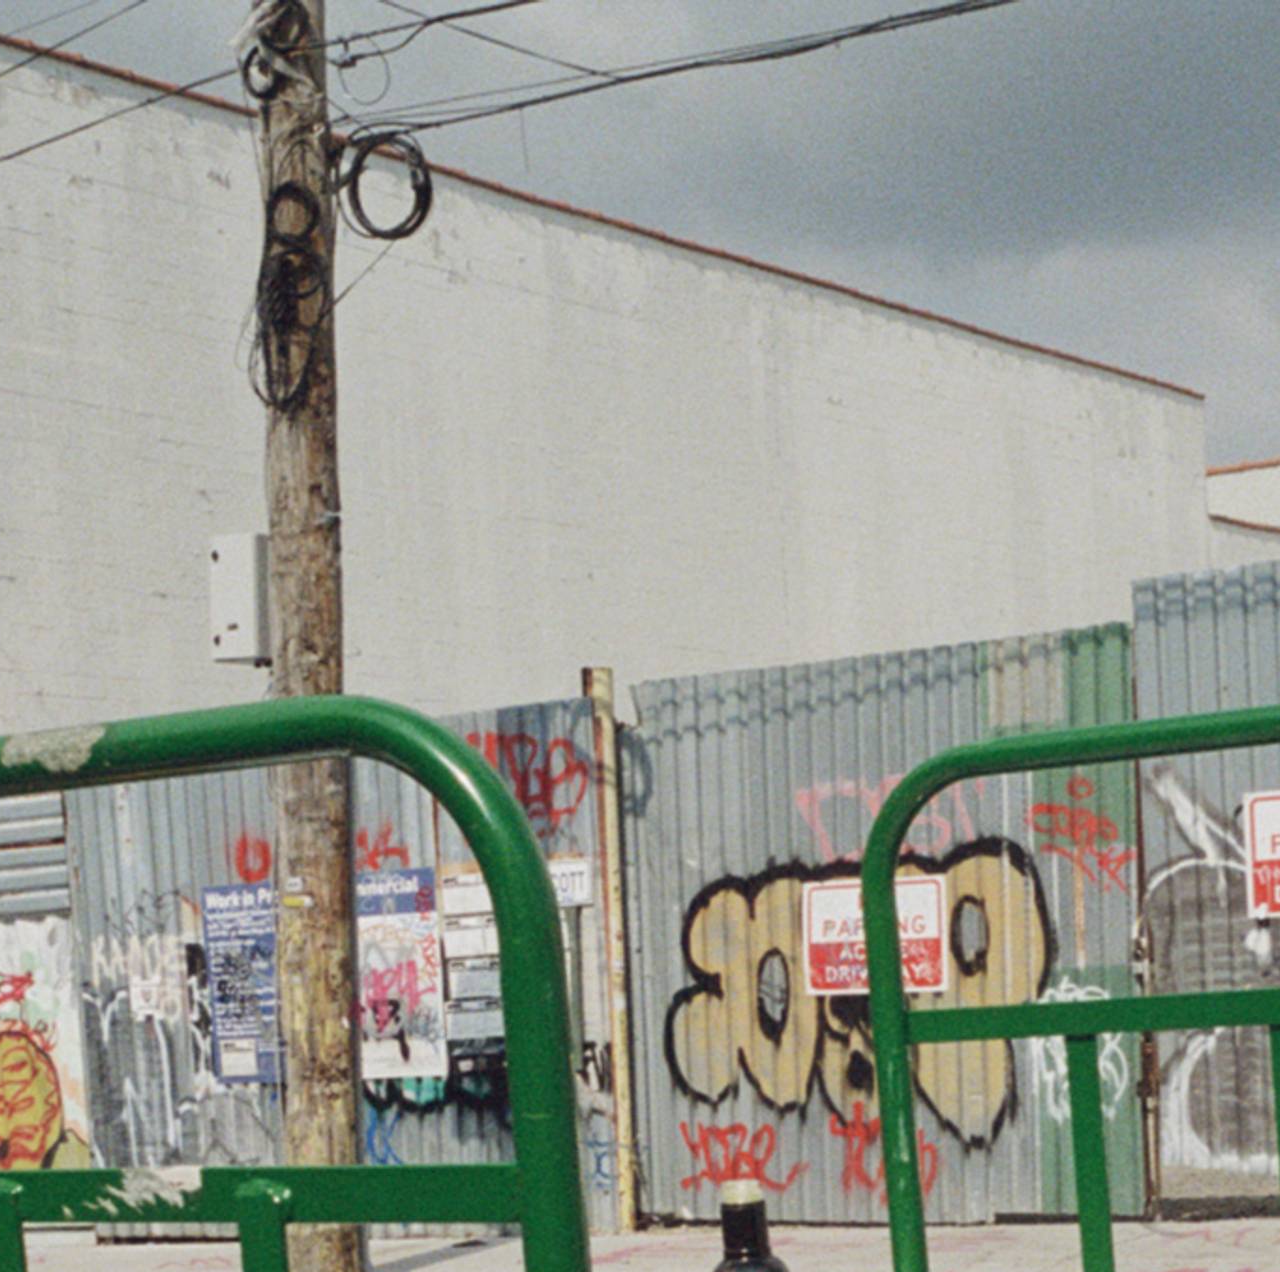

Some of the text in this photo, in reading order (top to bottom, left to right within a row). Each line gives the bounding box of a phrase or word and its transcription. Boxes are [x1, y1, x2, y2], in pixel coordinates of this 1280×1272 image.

[205, 891, 240, 909] Work
[242, 889, 255, 905] in
[822, 914, 927, 938] PARNG
